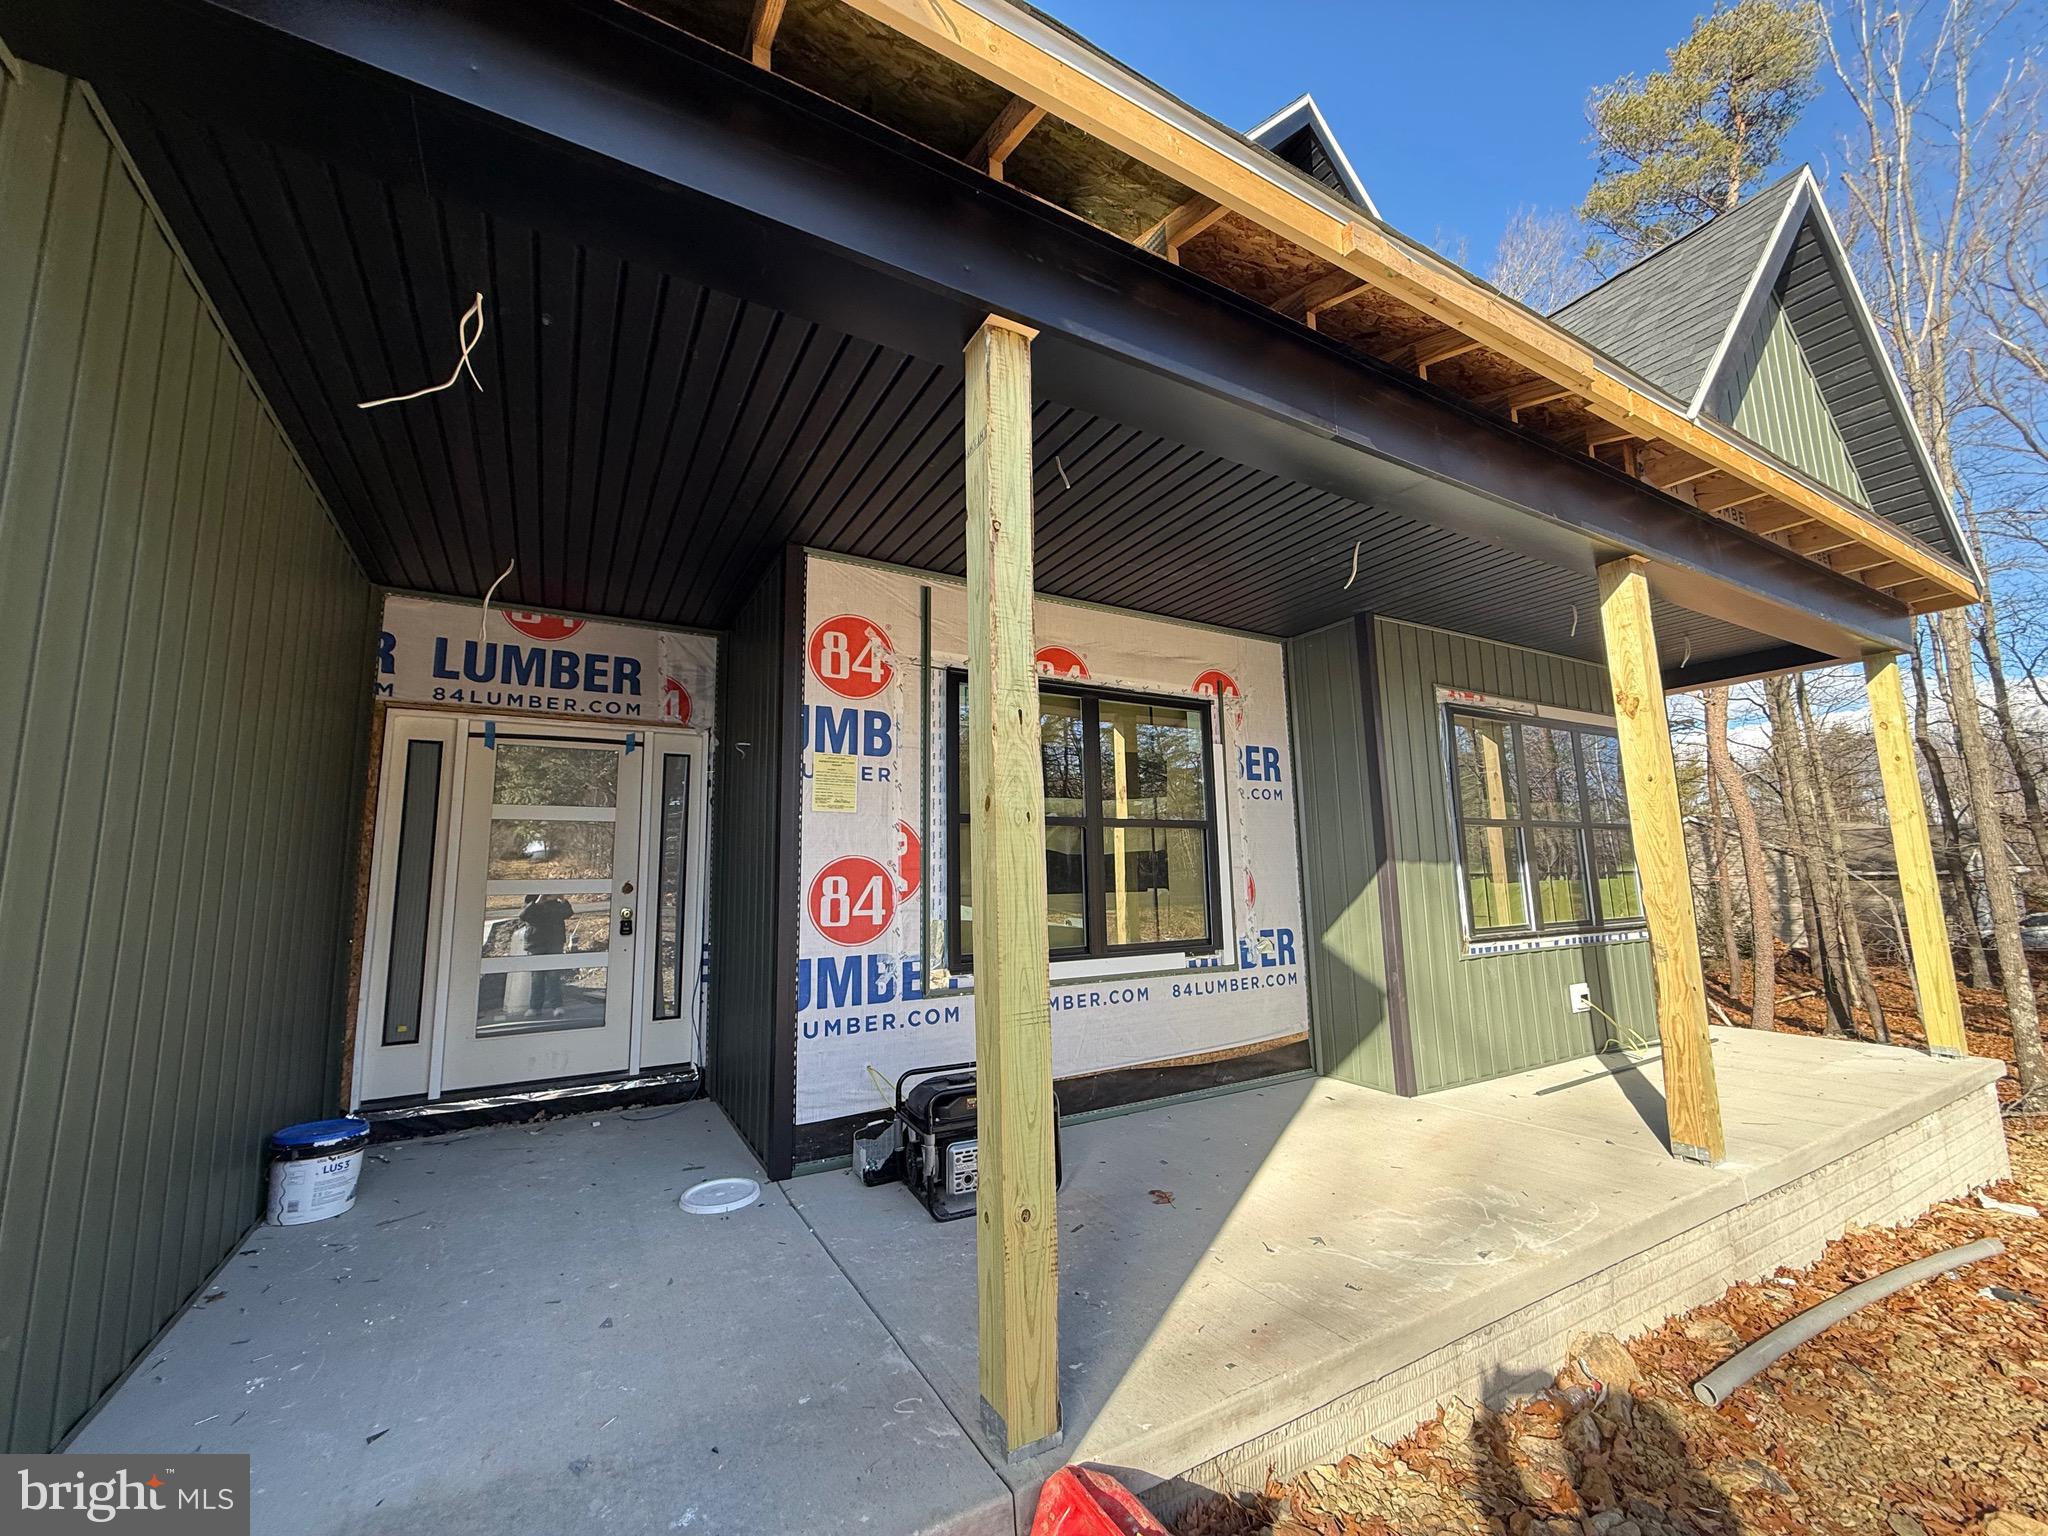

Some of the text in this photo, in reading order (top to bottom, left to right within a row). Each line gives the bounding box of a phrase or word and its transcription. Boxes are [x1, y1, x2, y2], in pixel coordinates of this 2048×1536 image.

[433, 637, 641, 696] LUMBER
[821, 627, 884, 683] 84
[433, 687, 641, 716] 84LUMBER.COM
[820, 876, 886, 927] 84
[1172, 972, 1297, 998] 84LUMBER.COM
[803, 1007, 960, 1040] UMBER.COM
